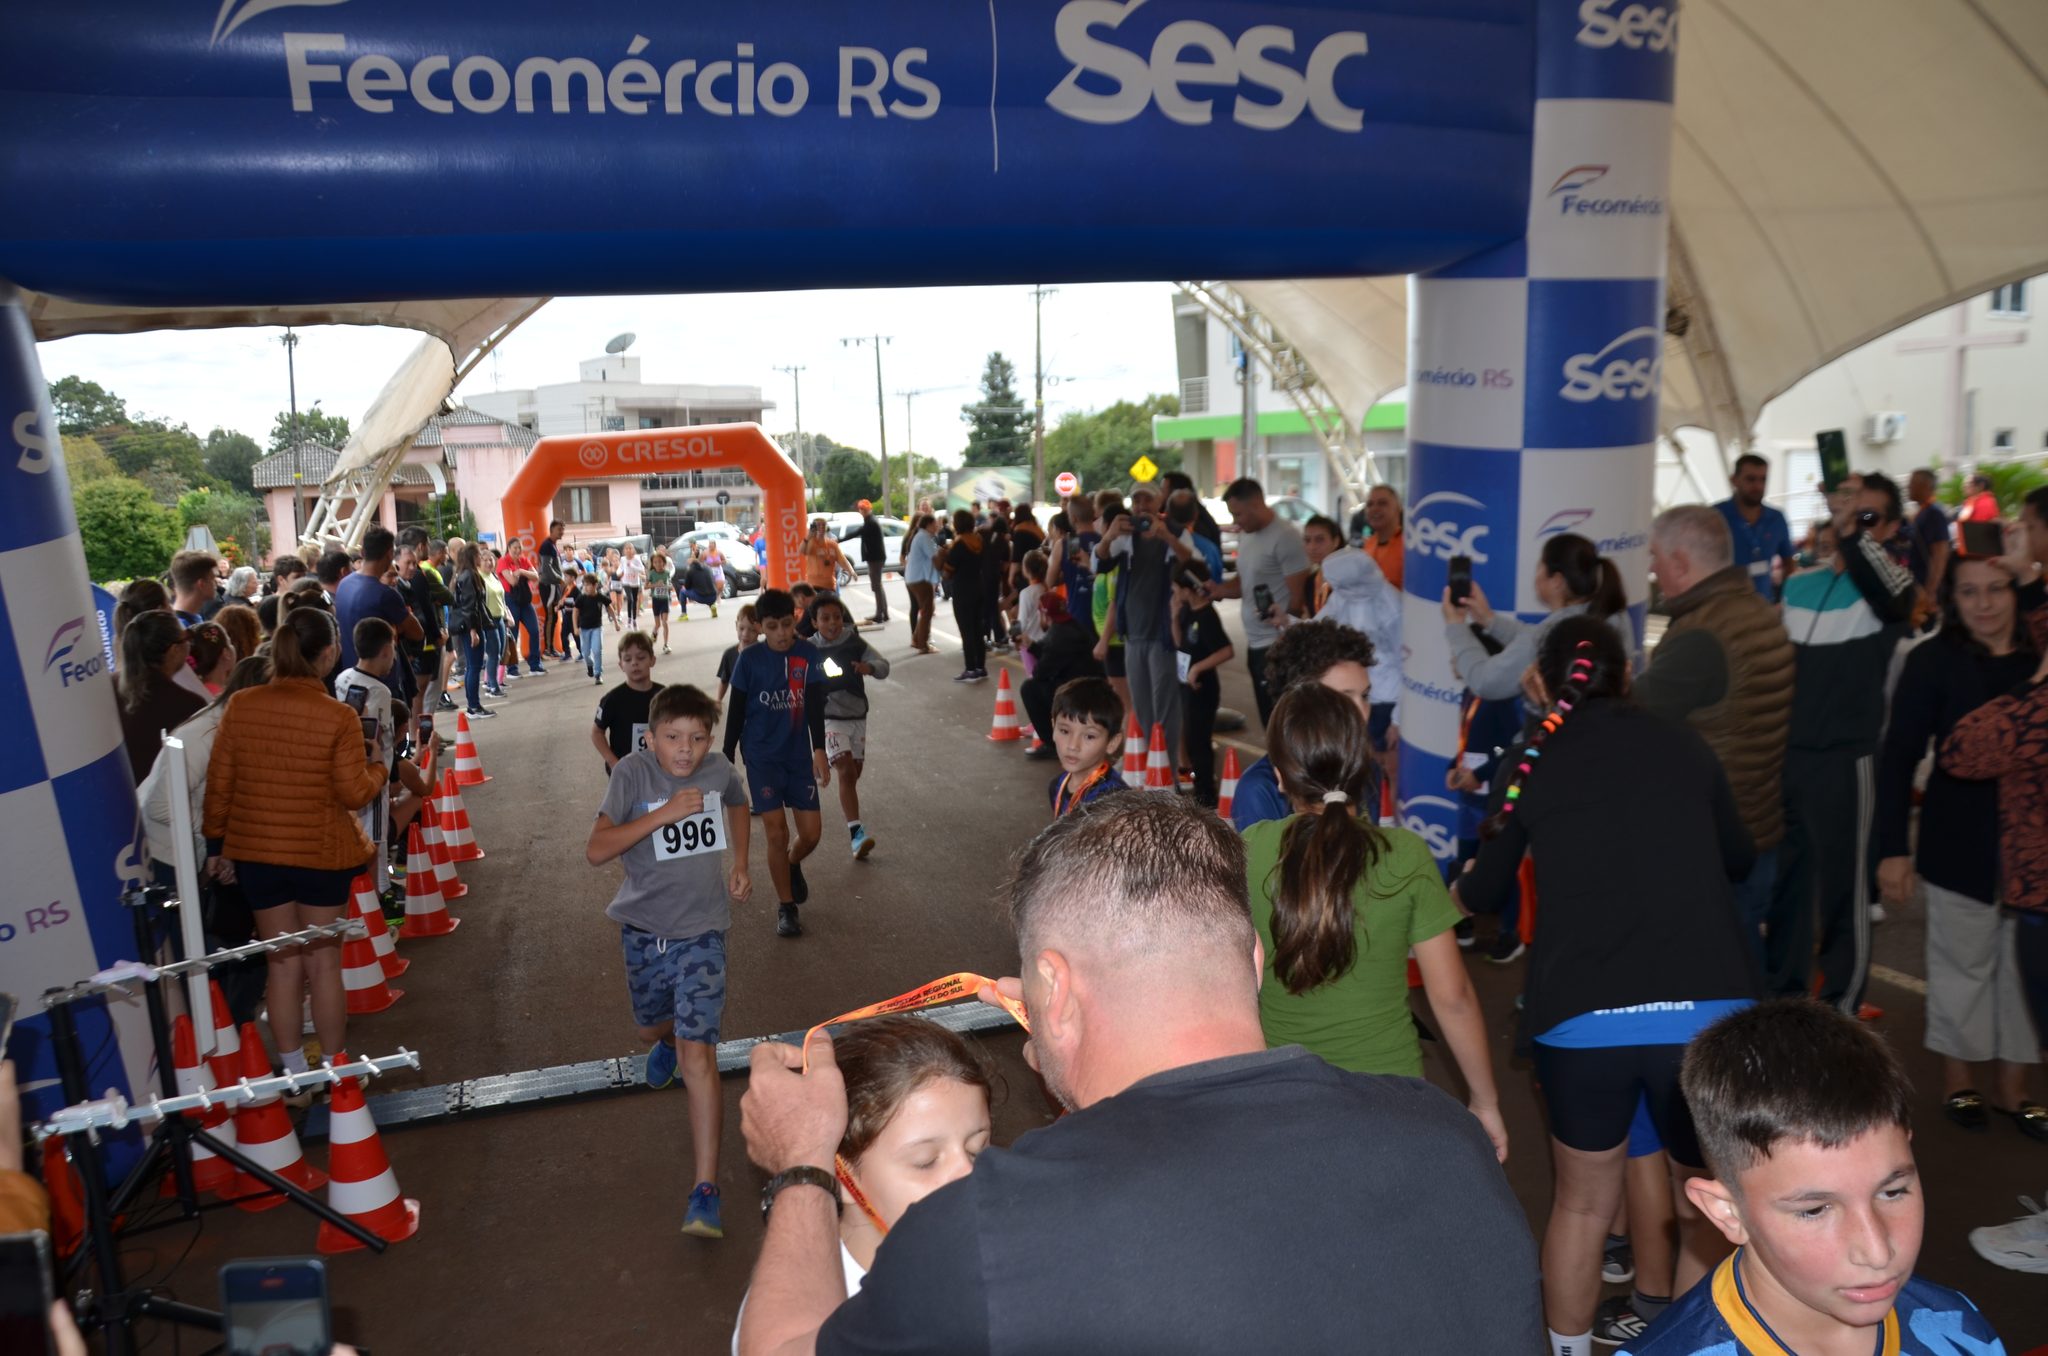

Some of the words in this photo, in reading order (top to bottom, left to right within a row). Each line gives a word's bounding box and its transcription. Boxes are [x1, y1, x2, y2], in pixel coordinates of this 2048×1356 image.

[283, 32, 810, 118] Fecomércio
[838, 45, 941, 119] RS
[1045, 0, 1369, 133] Sesc
[1483, 367, 1514, 388] RS
[616, 435, 724, 463] CRESOL
[781, 500, 805, 588] CRESOL
[759, 687, 805, 706] QATAR
[662, 816, 717, 854] 996
[25, 899, 70, 934] RS
[922, 977, 963, 997] REGIONAL
